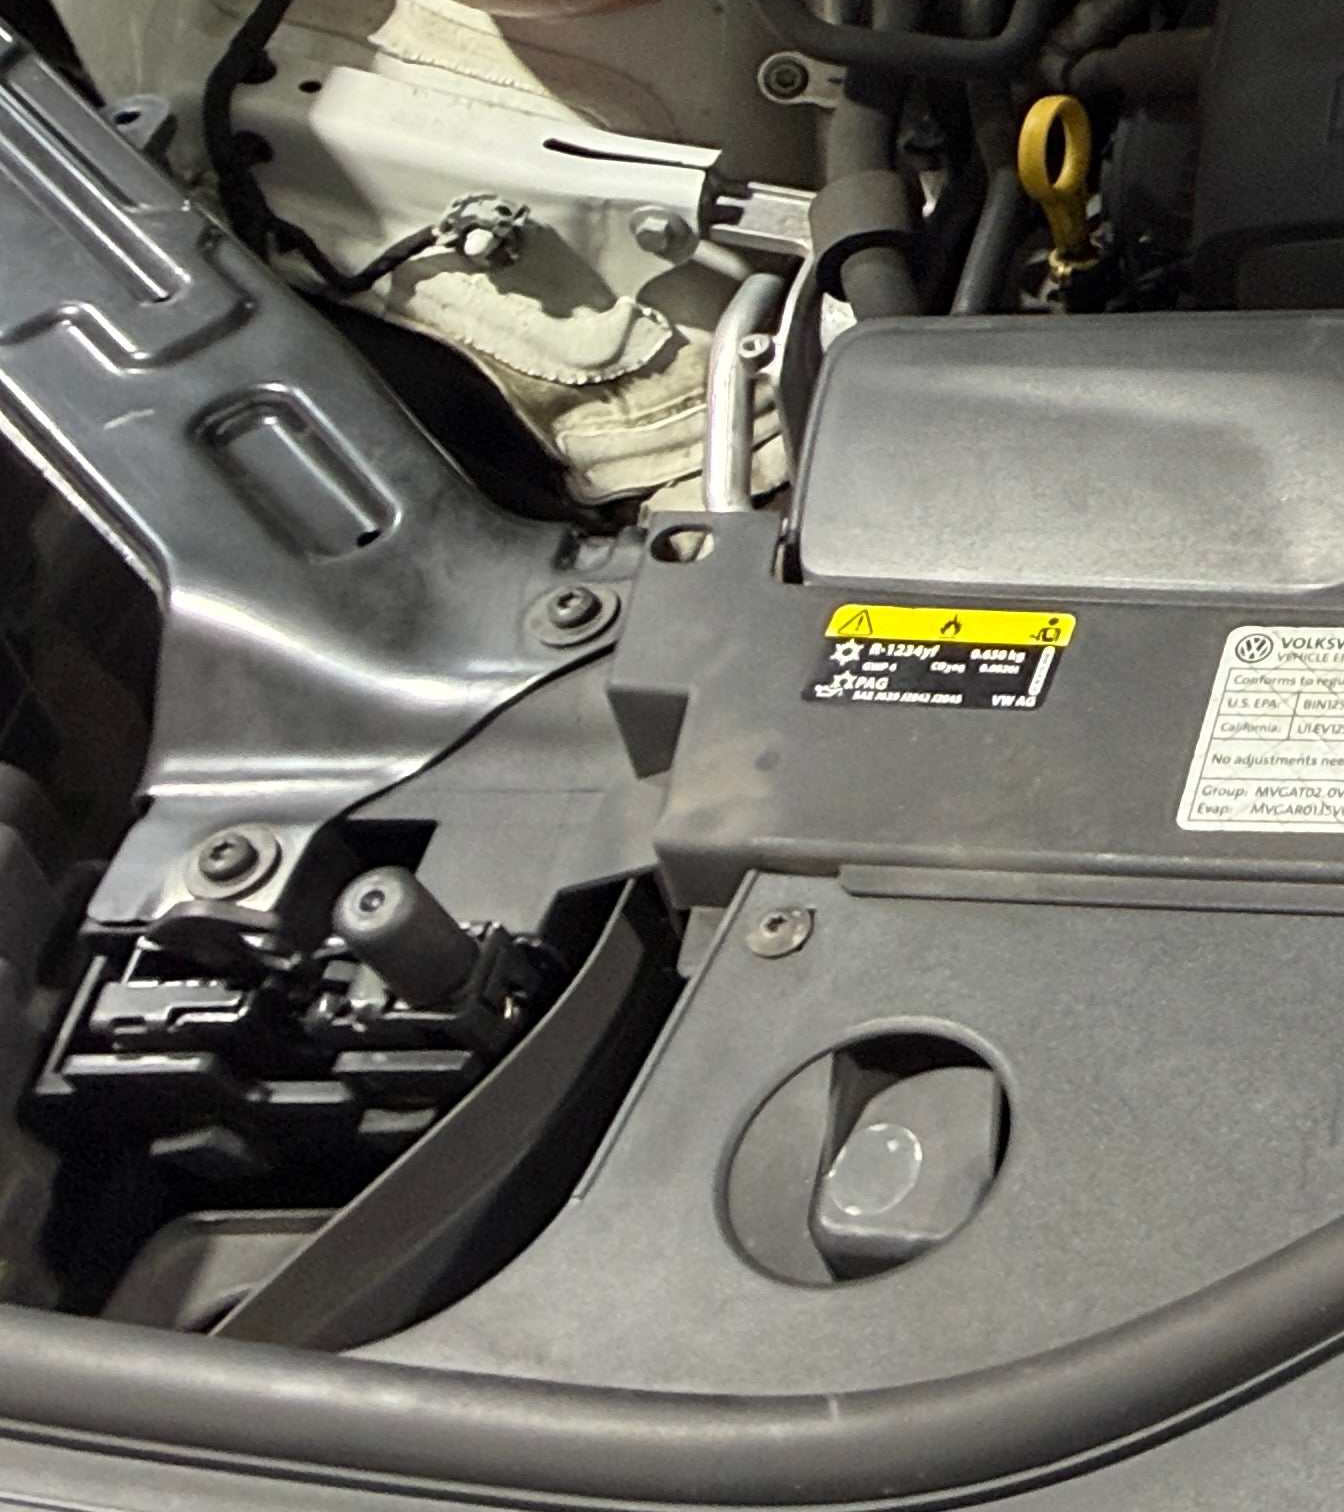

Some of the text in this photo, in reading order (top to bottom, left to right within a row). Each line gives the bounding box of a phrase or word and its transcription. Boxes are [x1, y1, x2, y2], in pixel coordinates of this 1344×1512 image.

[869, 644, 941, 658] R-1234yf
[1277, 652, 1330, 664] VEHICLE
[855, 676, 890, 690] PAG
[1233, 674, 1296, 686] Conforms
[1300, 675, 1314, 686] to
[991, 694, 1036, 707] VW AG
[1211, 753, 1231, 765] No
[1234, 754, 1317, 768] adjustments
